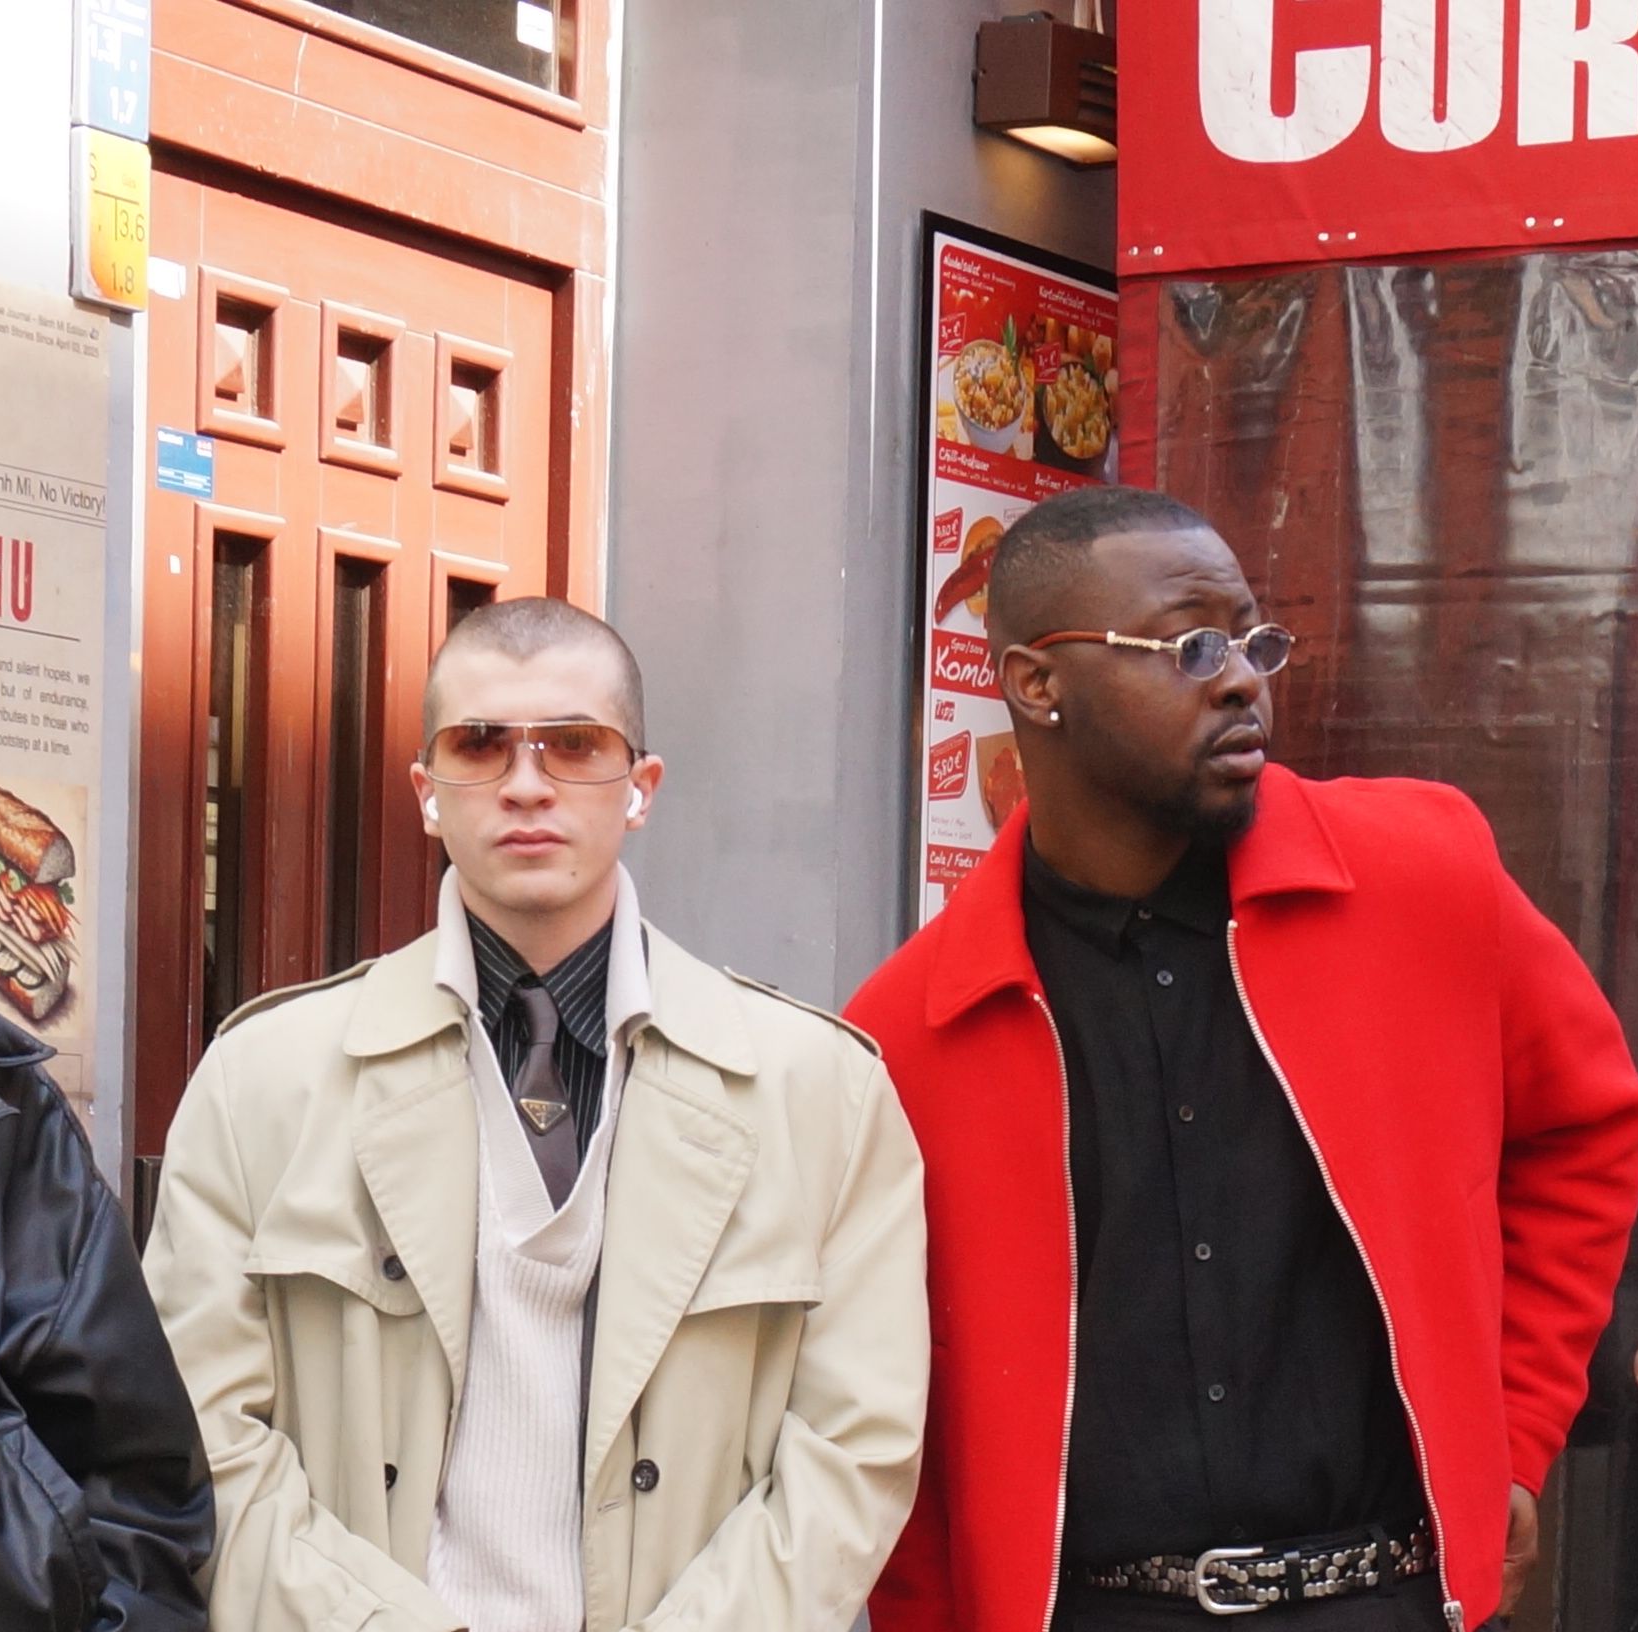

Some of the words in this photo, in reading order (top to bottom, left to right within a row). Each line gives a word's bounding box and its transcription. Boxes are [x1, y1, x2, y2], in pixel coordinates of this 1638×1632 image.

[40, 480, 57, 502] No
[60, 485, 105, 517] Victory!
[16, 662, 40, 677] silent
[44, 665, 73, 683] hopes,
[78, 673, 90, 685] we
[935, 646, 995, 687] Kombi
[1, 684, 15, 697] but
[23, 686, 33, 700] of
[31, 713, 40, 725] to
[43, 714, 66, 730] those
[71, 719, 88, 733] who
[33, 739, 41, 750] at
[51, 741, 72, 755] time.
